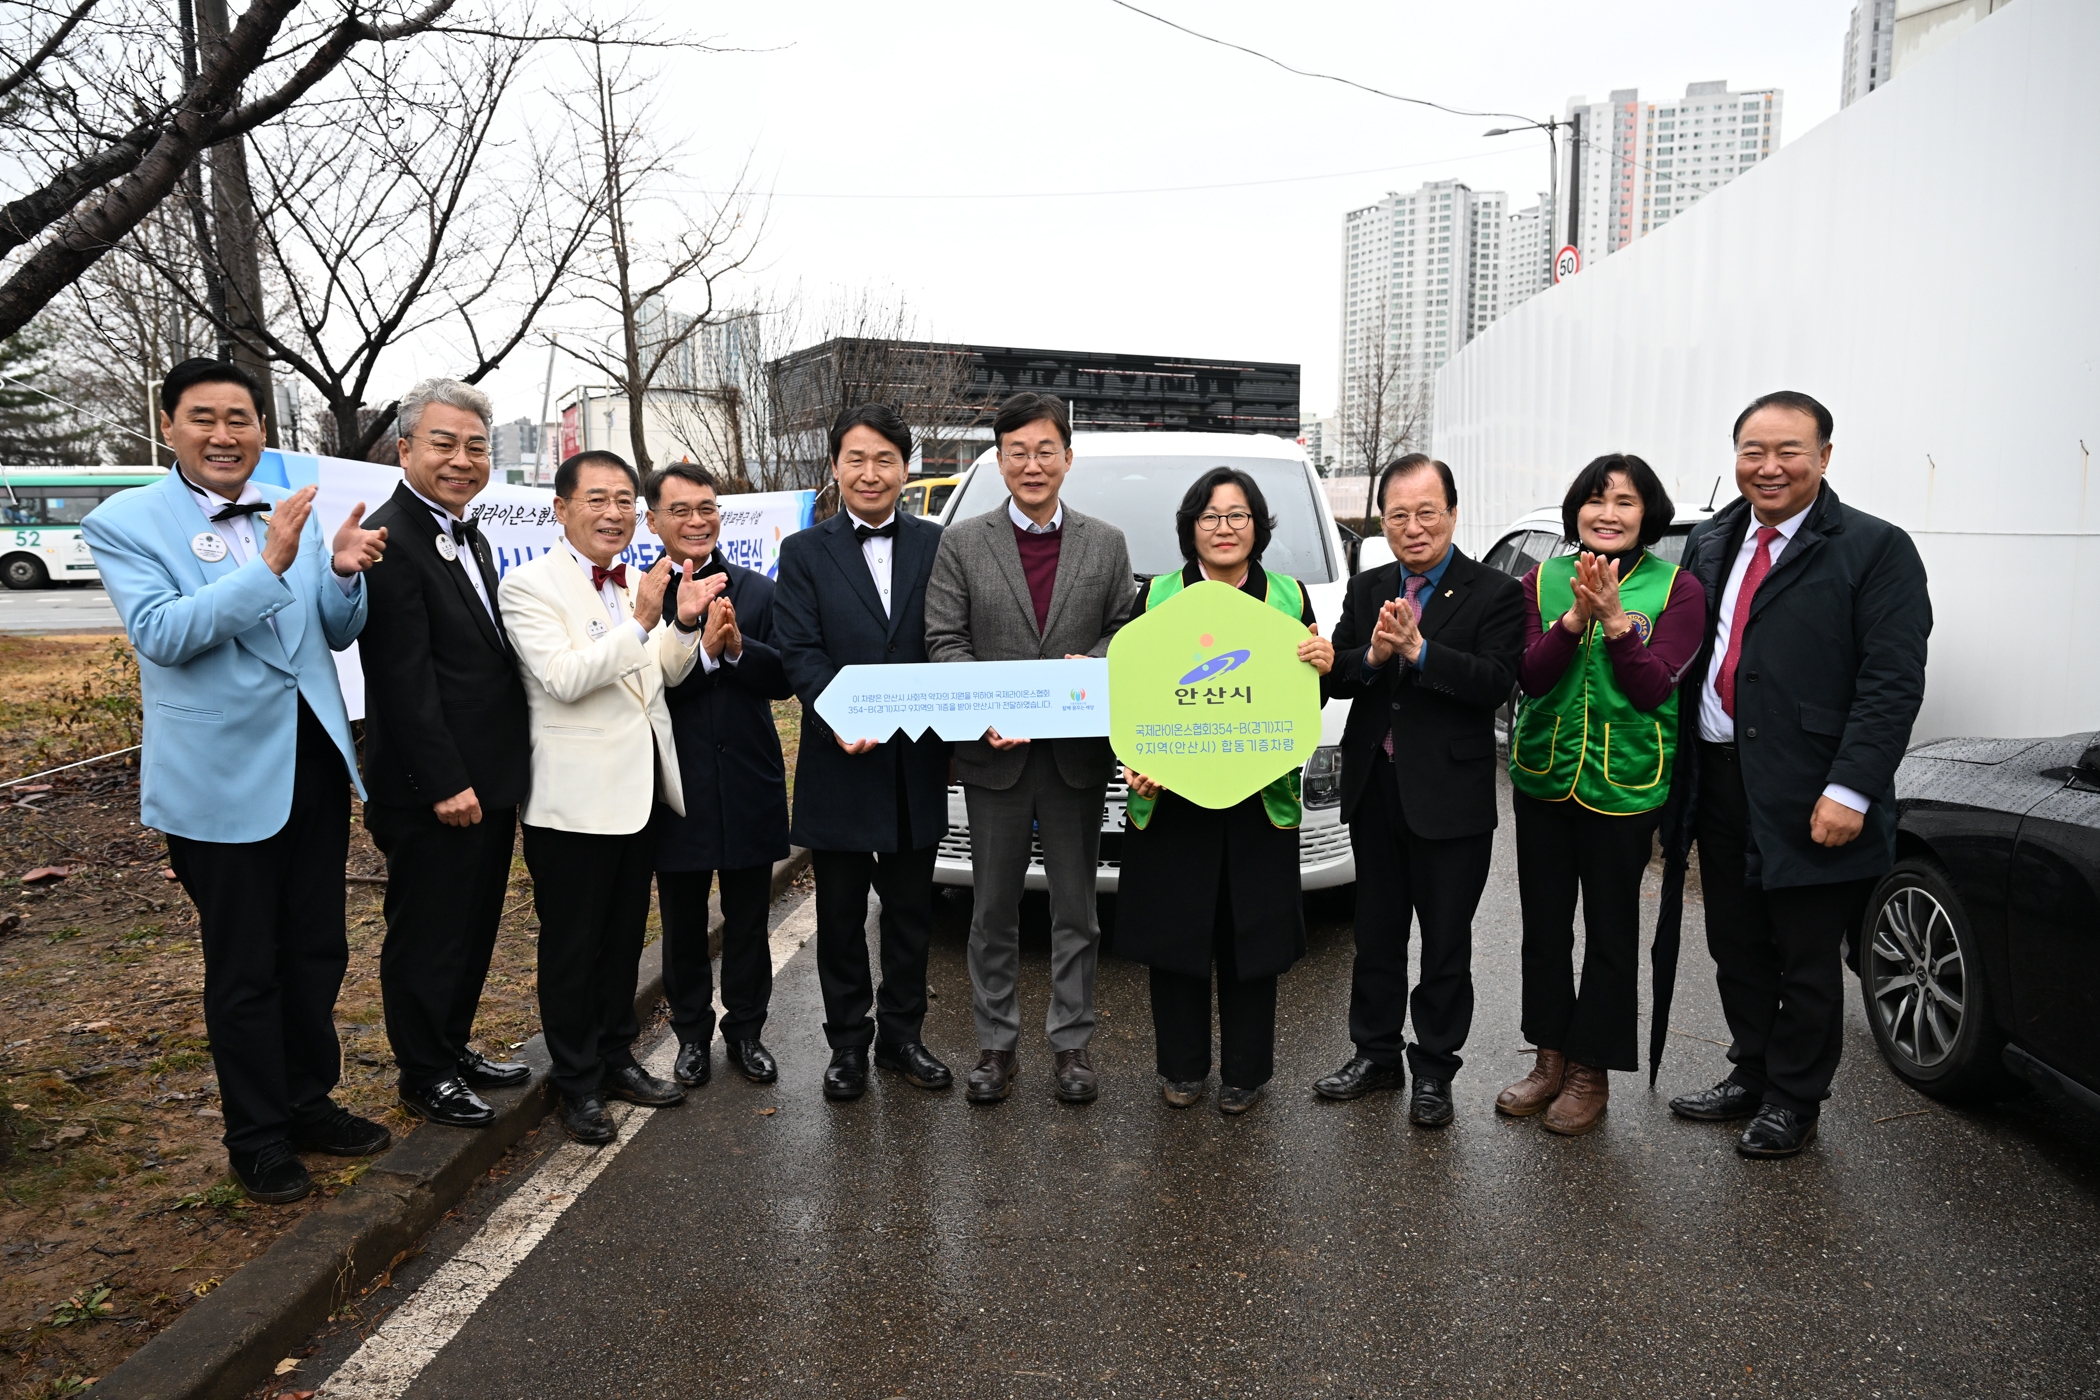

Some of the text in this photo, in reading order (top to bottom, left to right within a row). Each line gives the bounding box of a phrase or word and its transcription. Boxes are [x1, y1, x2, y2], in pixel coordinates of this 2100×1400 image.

[1560, 257, 1574, 276] 50
[15, 531, 41, 546] 52
[1627, 615, 1646, 625] LIONS
[852, 689, 1051, 703] 이 차량은 안산시 사회적 약자의 지원을 위하여 국제라이온스협회
[1174, 686, 1252, 705] 안산시
[848, 700, 1053, 714] 354-B(경기)지구 9지역의 기증을 받아 안산시가 전달하였습니다.
[1135, 720, 1294, 737] 국제라이온스협회354-B(경기)지구
[1135, 738, 1295, 755] 9지역(안산시) 합동기증차량
